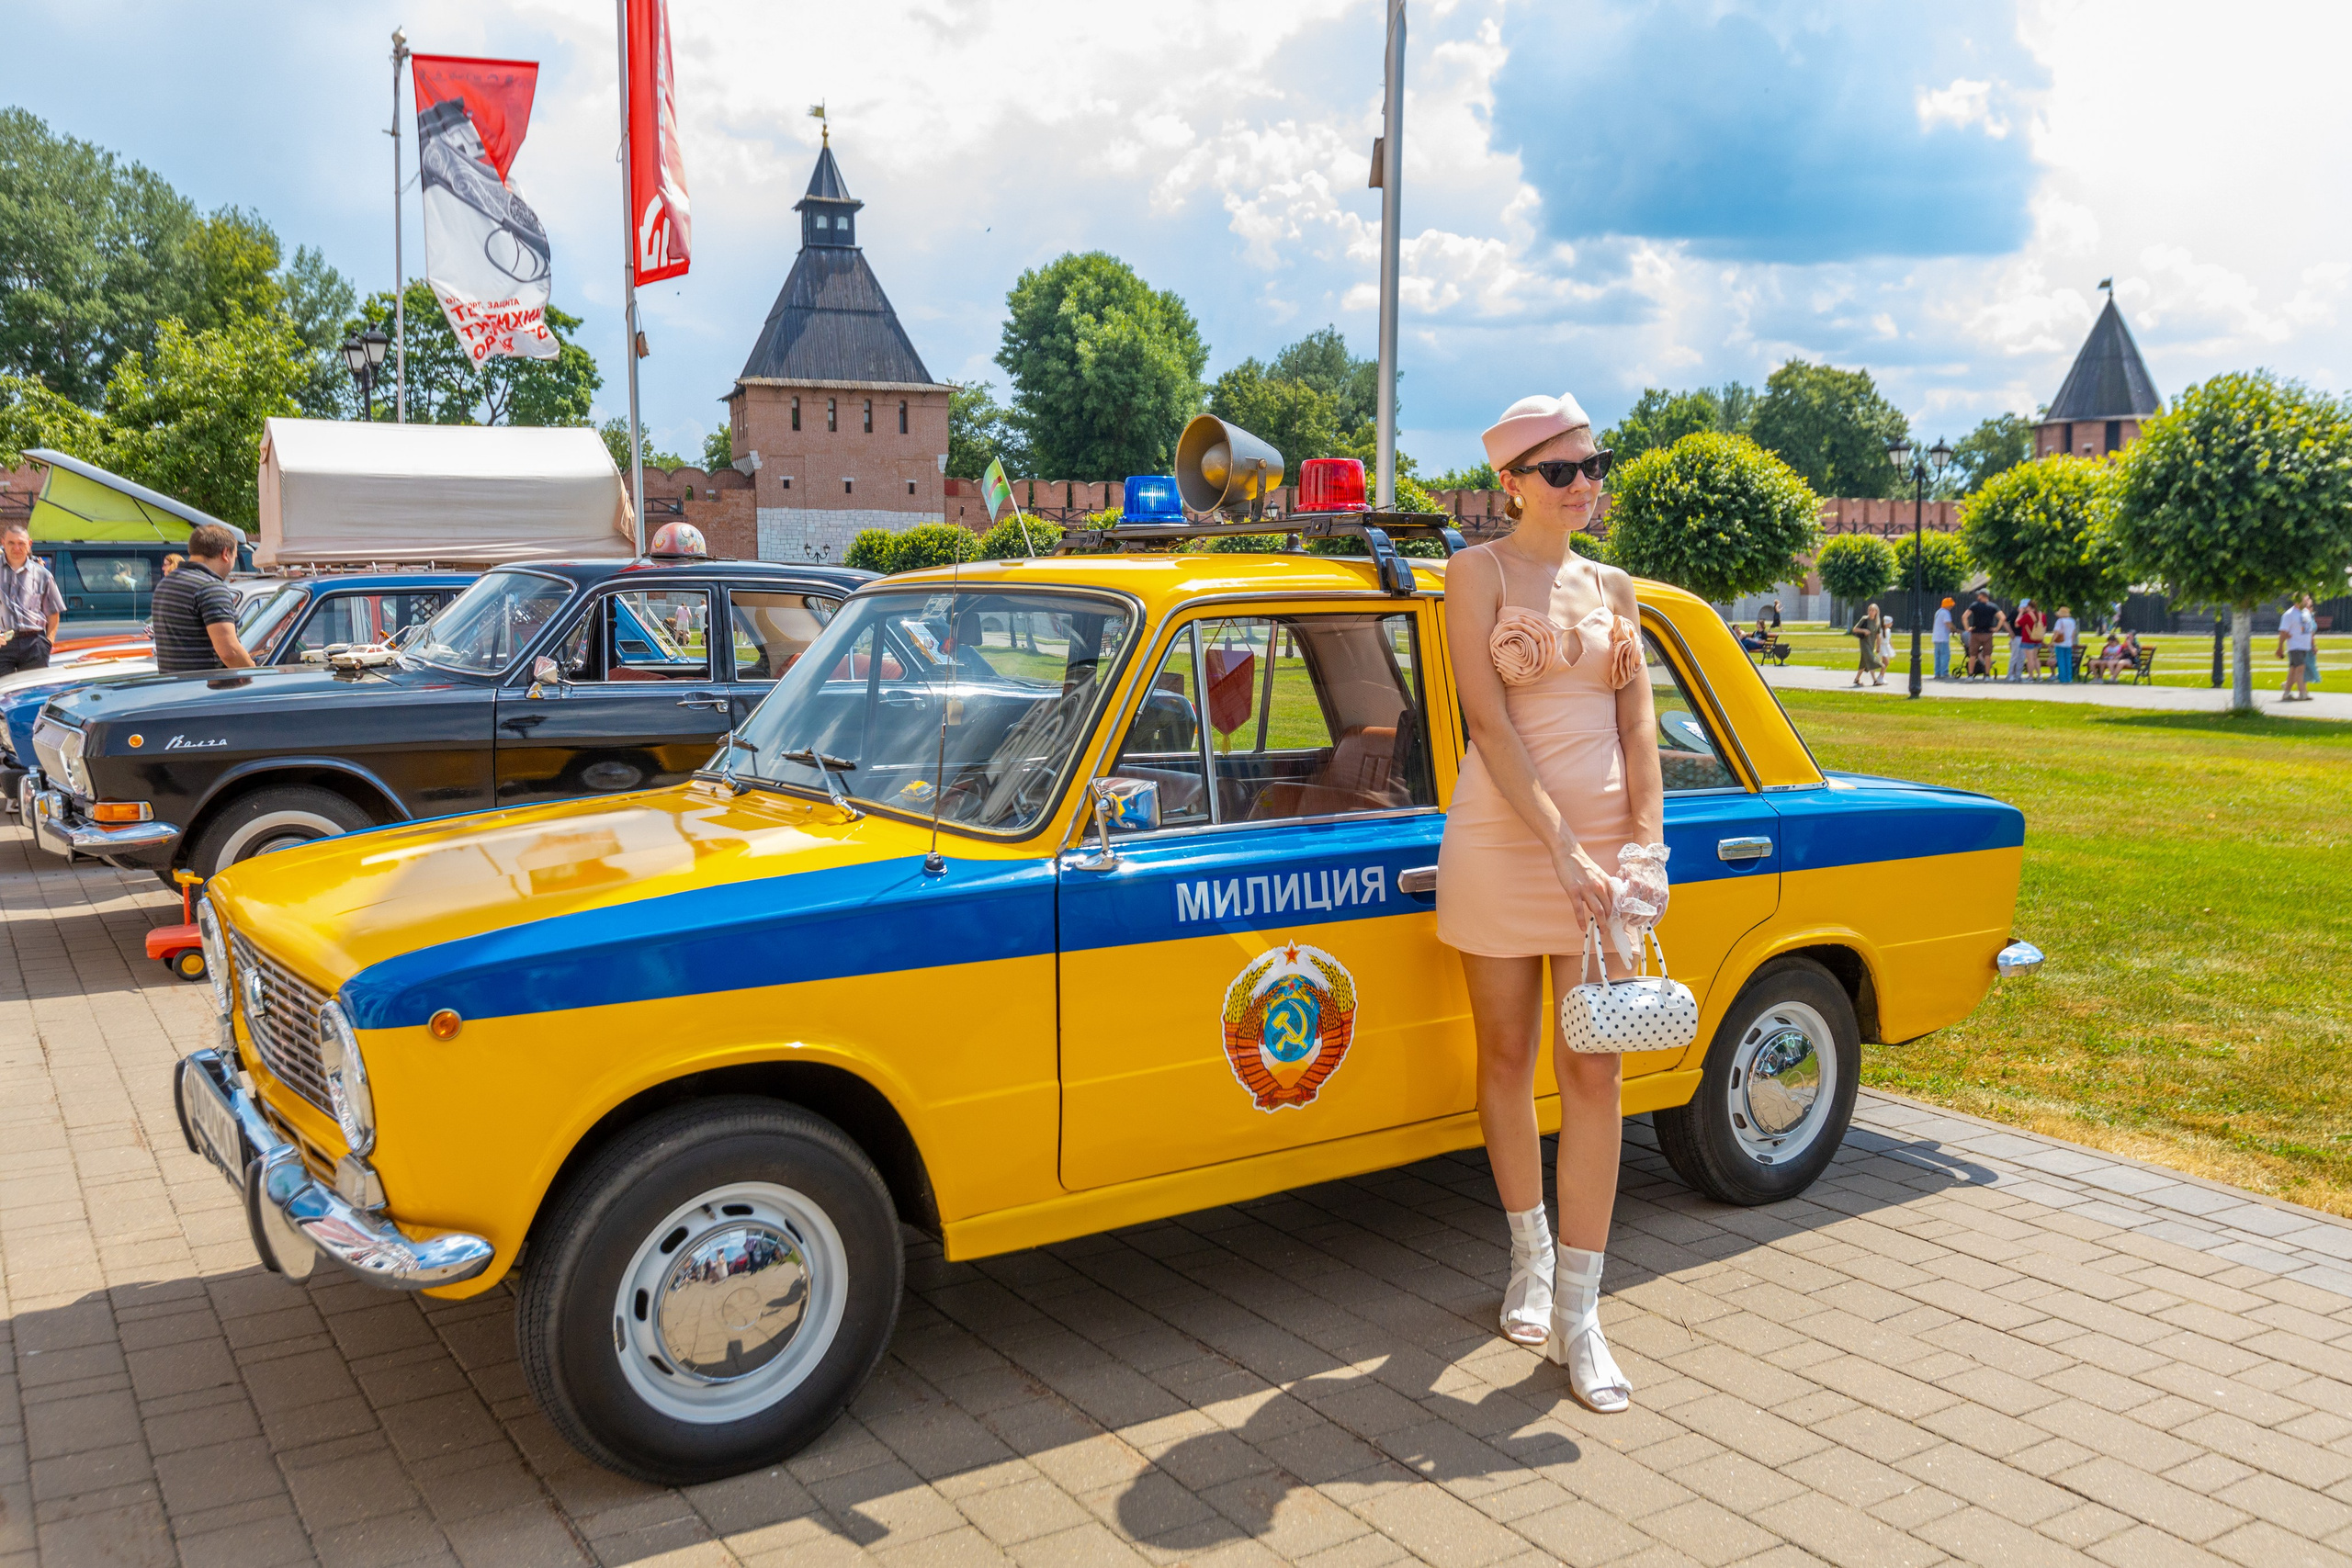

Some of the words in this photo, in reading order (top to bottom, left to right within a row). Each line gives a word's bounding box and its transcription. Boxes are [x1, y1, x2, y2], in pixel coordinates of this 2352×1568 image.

[488, 298, 520, 309] ЗАЩИТА
[164, 735, 227, 750] Волга
[1176, 865, 1386, 922] МИЛИЦИЯ
